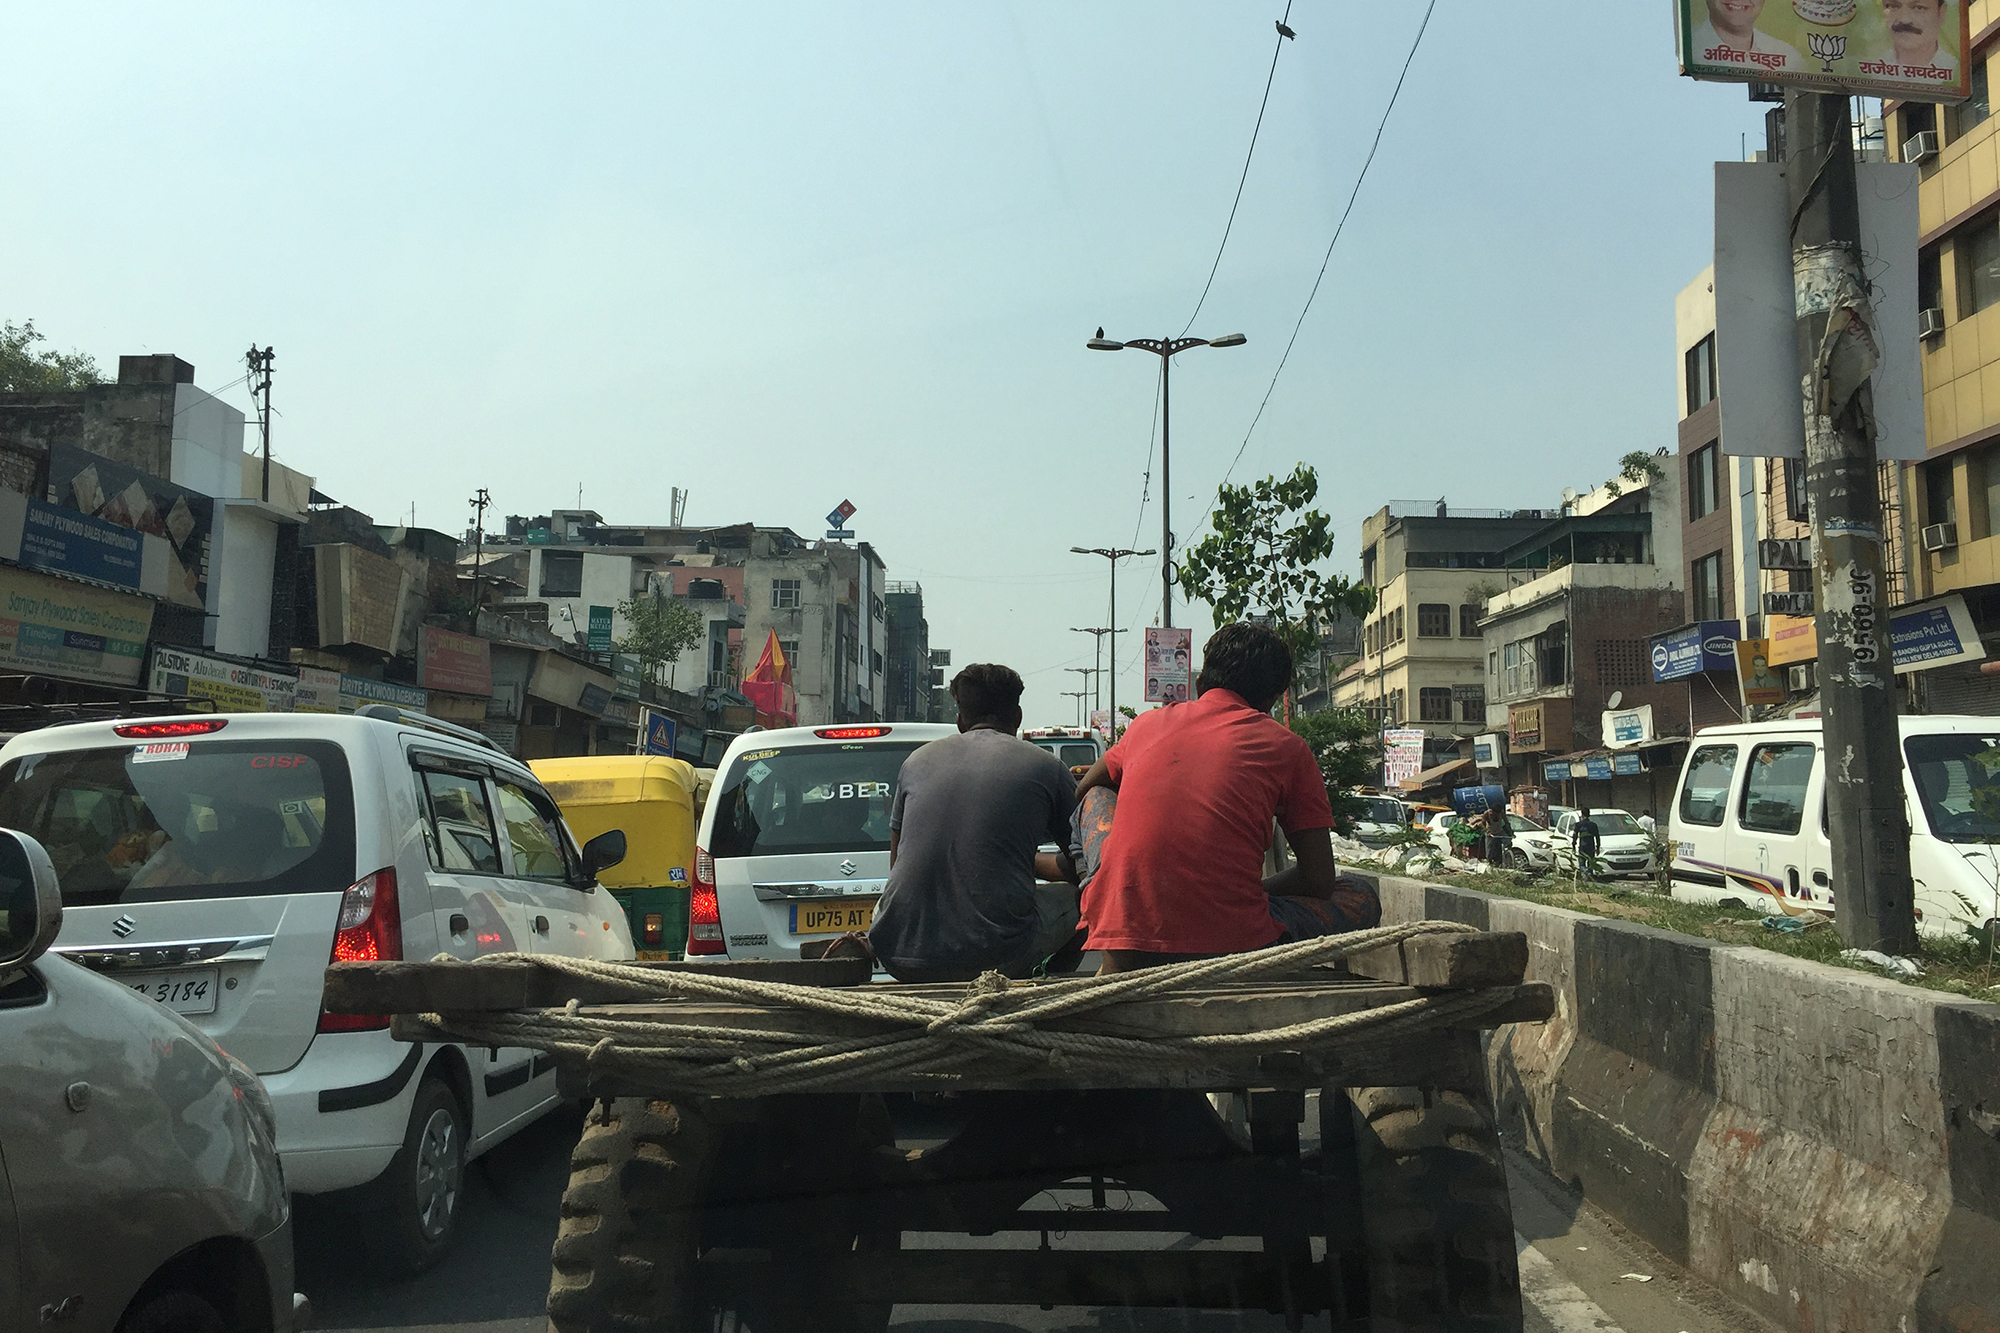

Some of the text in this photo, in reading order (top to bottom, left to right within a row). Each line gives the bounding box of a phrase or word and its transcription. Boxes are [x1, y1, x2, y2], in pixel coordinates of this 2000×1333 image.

[1704, 44, 1746, 63] अमित
[1859, 59, 1900, 76] राजेश
[1903, 63, 1953, 81] सचदेवा
[54, 515, 84, 537] PLYWOOD
[8, 590, 39, 619] Sanjay
[41, 597, 80, 622] Plywood
[25, 625, 59, 642] Timber
[70, 634, 101, 649] Sunmica
[1890, 622, 1951, 645] Extrusions Pvt. Ltd.
[1919, 643, 1938, 653] GUPTA
[1938, 639, 1956, 649] ROAD,
[157, 650, 190, 673] ALSTONE
[341, 677, 363, 695] BRITE
[363, 682, 395, 702] PLYWOOD
[395, 689, 426, 706] AGENCIES
[146, 743, 190, 754] ROHAN
[742, 750, 780, 761] KULDEEP
[251, 755, 308, 769] CISF
[751, 768, 767, 777] CNG
[806, 911, 842, 928] UP75
[848, 910, 864, 926] AT
[730, 939, 768, 947] SUZUKI
[155, 980, 209, 1003] 3184
